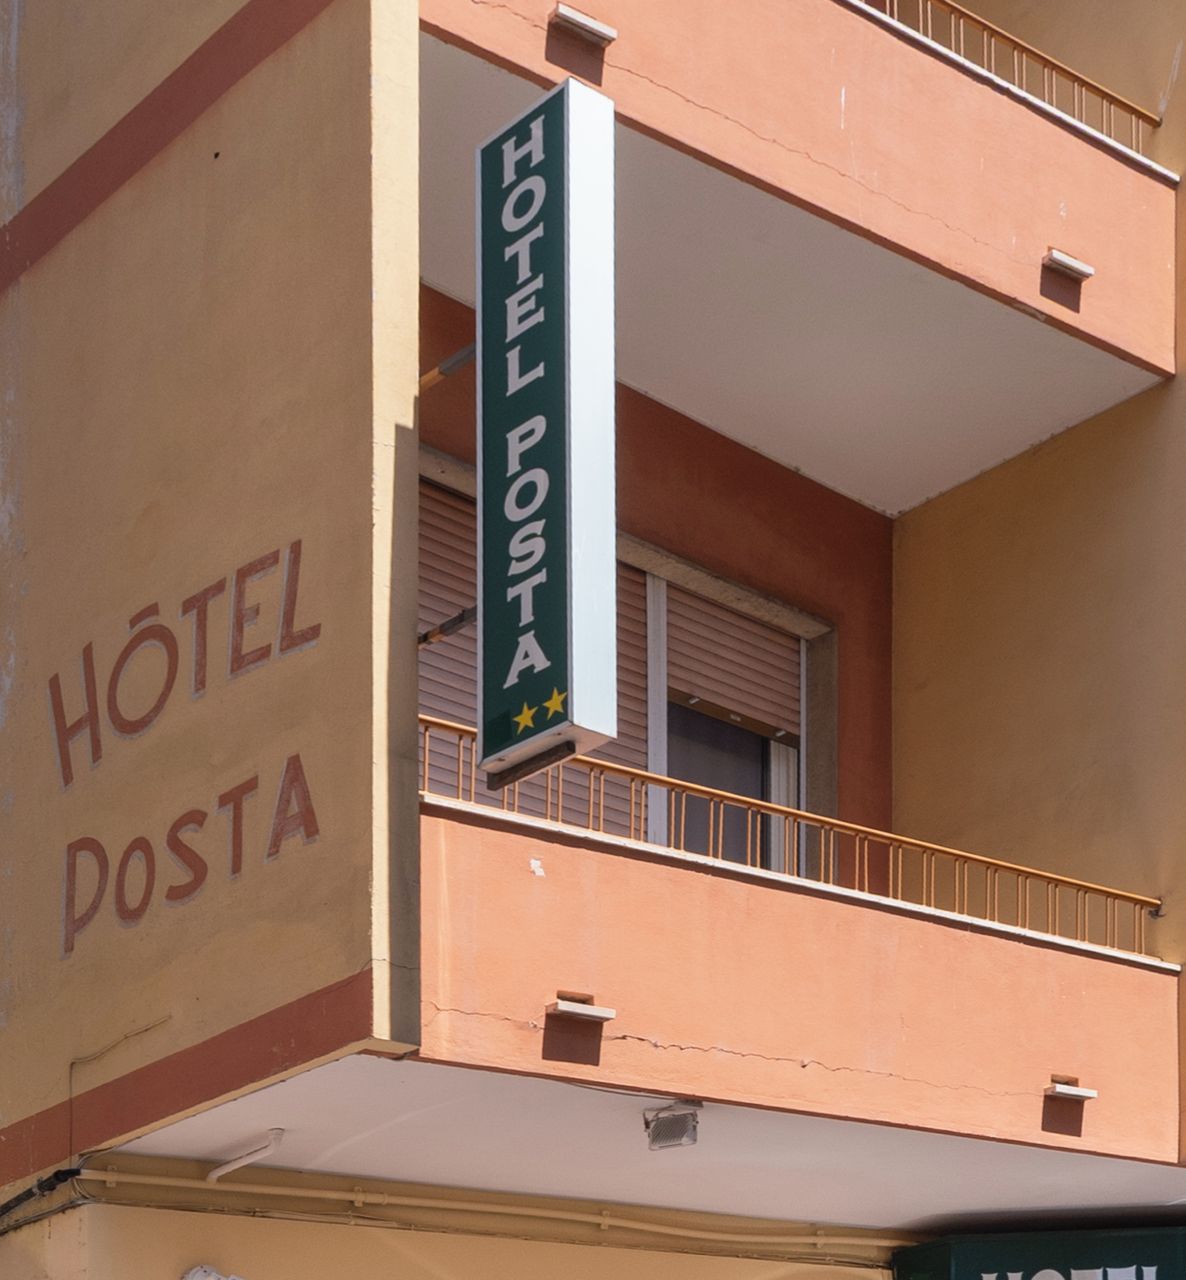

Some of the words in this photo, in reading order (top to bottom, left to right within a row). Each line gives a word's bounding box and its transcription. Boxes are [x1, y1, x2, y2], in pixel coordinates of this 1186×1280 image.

[501, 114, 547, 397] HOTEL
[502, 415, 550, 690] POSTA
[60, 753, 320, 959] POSTA
